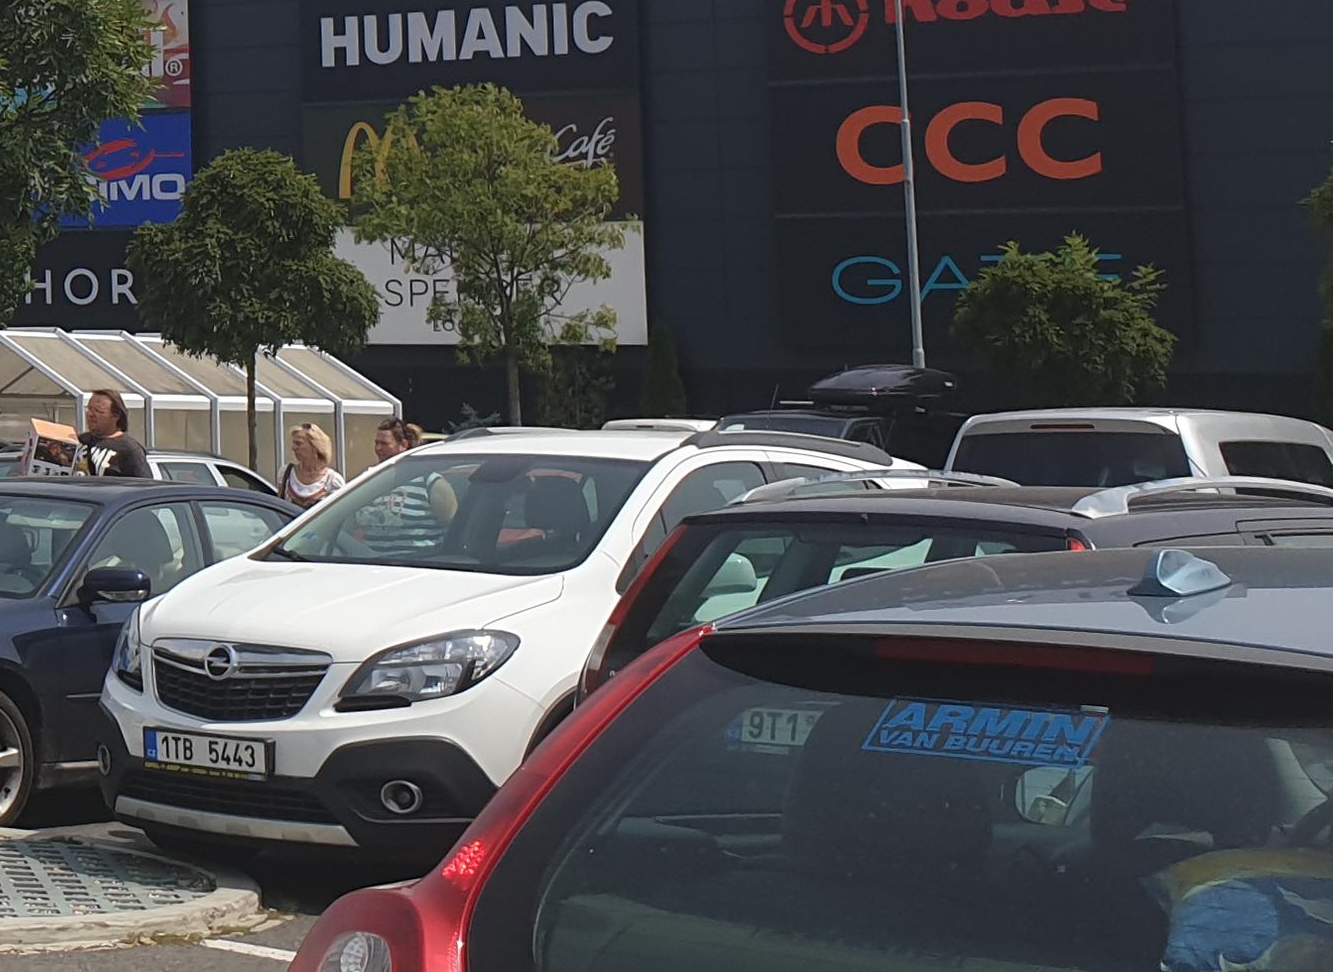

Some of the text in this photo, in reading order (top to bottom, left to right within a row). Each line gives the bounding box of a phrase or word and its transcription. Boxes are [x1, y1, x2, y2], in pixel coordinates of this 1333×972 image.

[320, 0, 614, 69] HUMANIC
[836, 97, 1102, 185] CCC
[748, 711, 799, 741] 9T1
[883, 701, 1102, 745] ARMIN
[161, 734, 194, 761] 1TB
[208, 740, 256, 768] 5443
[879, 729, 1084, 763] VAN BUUREN
